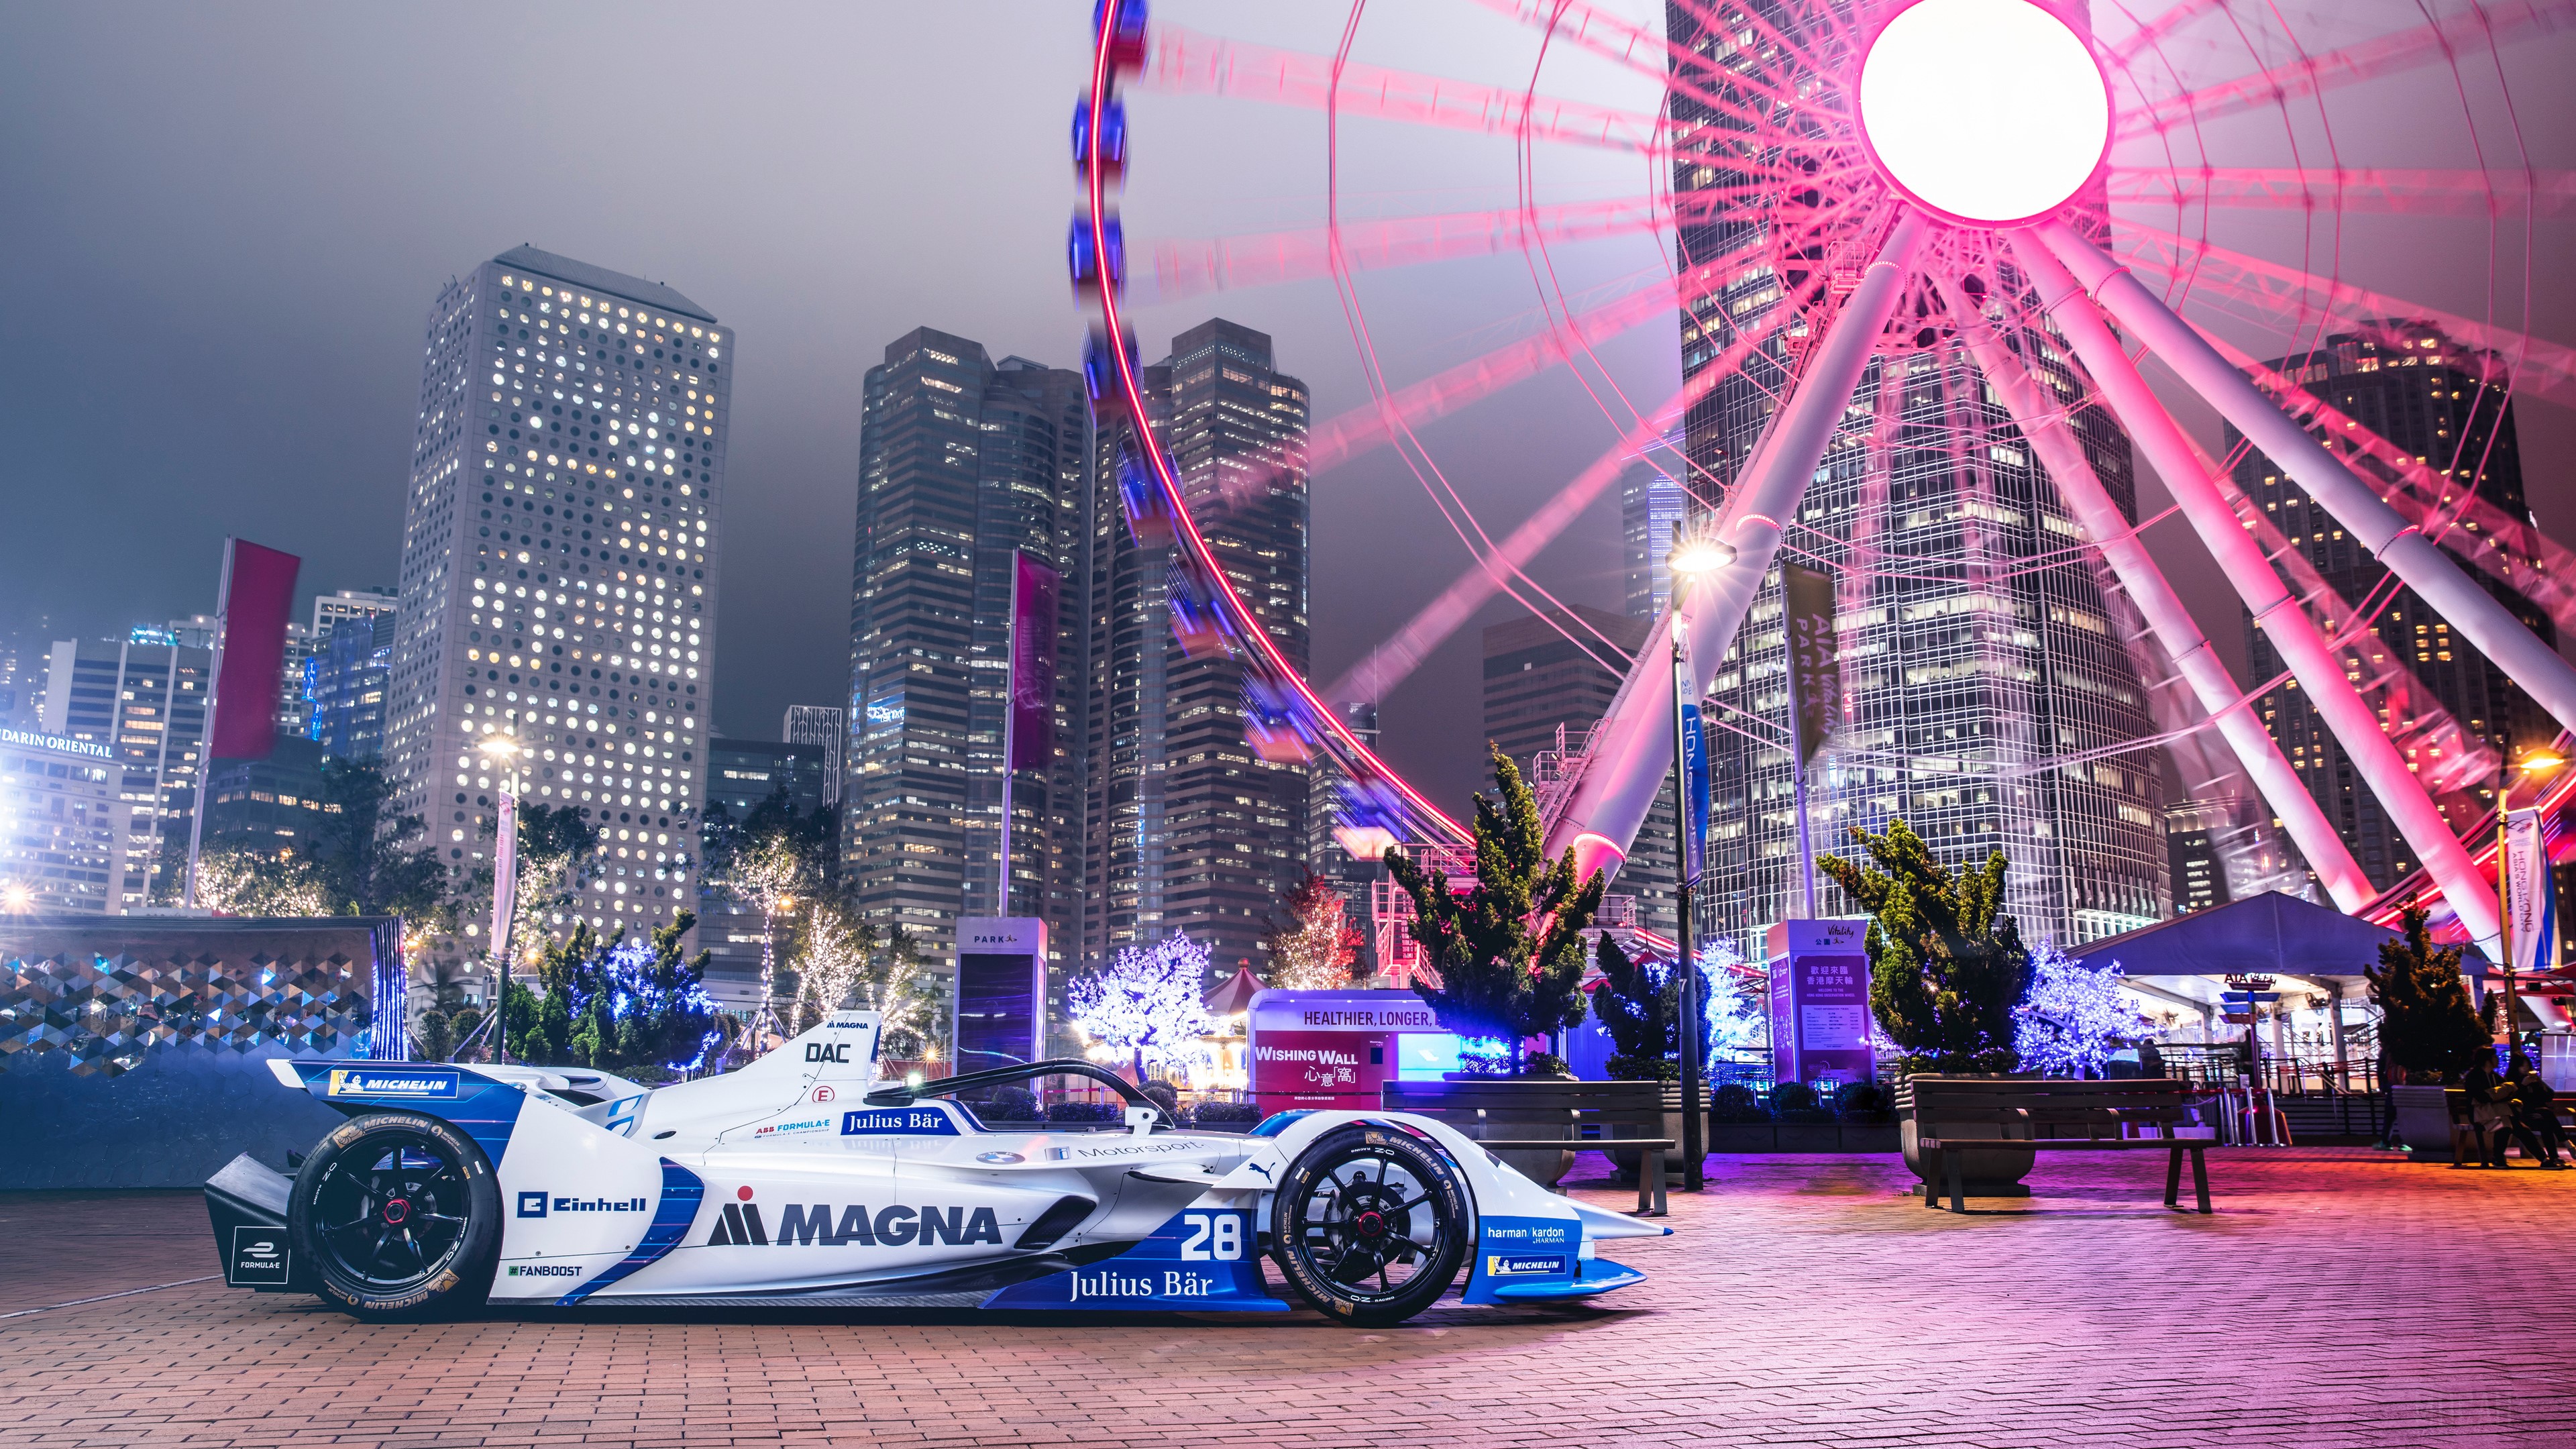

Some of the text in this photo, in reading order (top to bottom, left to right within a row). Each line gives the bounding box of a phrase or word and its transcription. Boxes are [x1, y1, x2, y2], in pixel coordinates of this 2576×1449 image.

[1812, 613, 1835, 668] AIA
[1796, 618, 1816, 686] PARK
[0, 728, 113, 758] DARIN ORIENTAL
[2517, 851, 2528, 890] HONG
[2516, 881, 2524, 912] WORLD
[2522, 893, 2534, 932] KONG
[1828, 924, 1854, 938] Vitality
[1811, 966, 1848, 975] 歡迎來臨
[2224, 973, 2247, 983] AIA
[1807, 977, 1854, 985] 香港摩天輪
[1304, 1011, 1377, 1027] HEALTHIER,
[1380, 1011, 1432, 1027] LONGER,
[805, 1043, 851, 1063] DAC
[366, 1079, 447, 1090] MICHELIN
[364, 1116, 429, 1128] MICHELIN
[849, 1114, 943, 1132] Julius Bär
[443, 1132, 461, 1147] MICHELIN
[1389, 1136, 1444, 1175] MICHELIN
[313, 1184, 321, 1205] RACING
[553, 1197, 646, 1212] Einhell
[1450, 1189, 1459, 1210] MICHELIN
[777, 1203, 1003, 1246] MAGNA
[1181, 1214, 1242, 1261] 28
[510, 1266, 582, 1276] #FANBOOST
[1512, 1261, 1560, 1270] MICHELIN
[1070, 1271, 1213, 1302] Julius Bär
[1287, 1250, 1332, 1303] MICHELIN
[364, 1291, 429, 1309] MICHELIN
